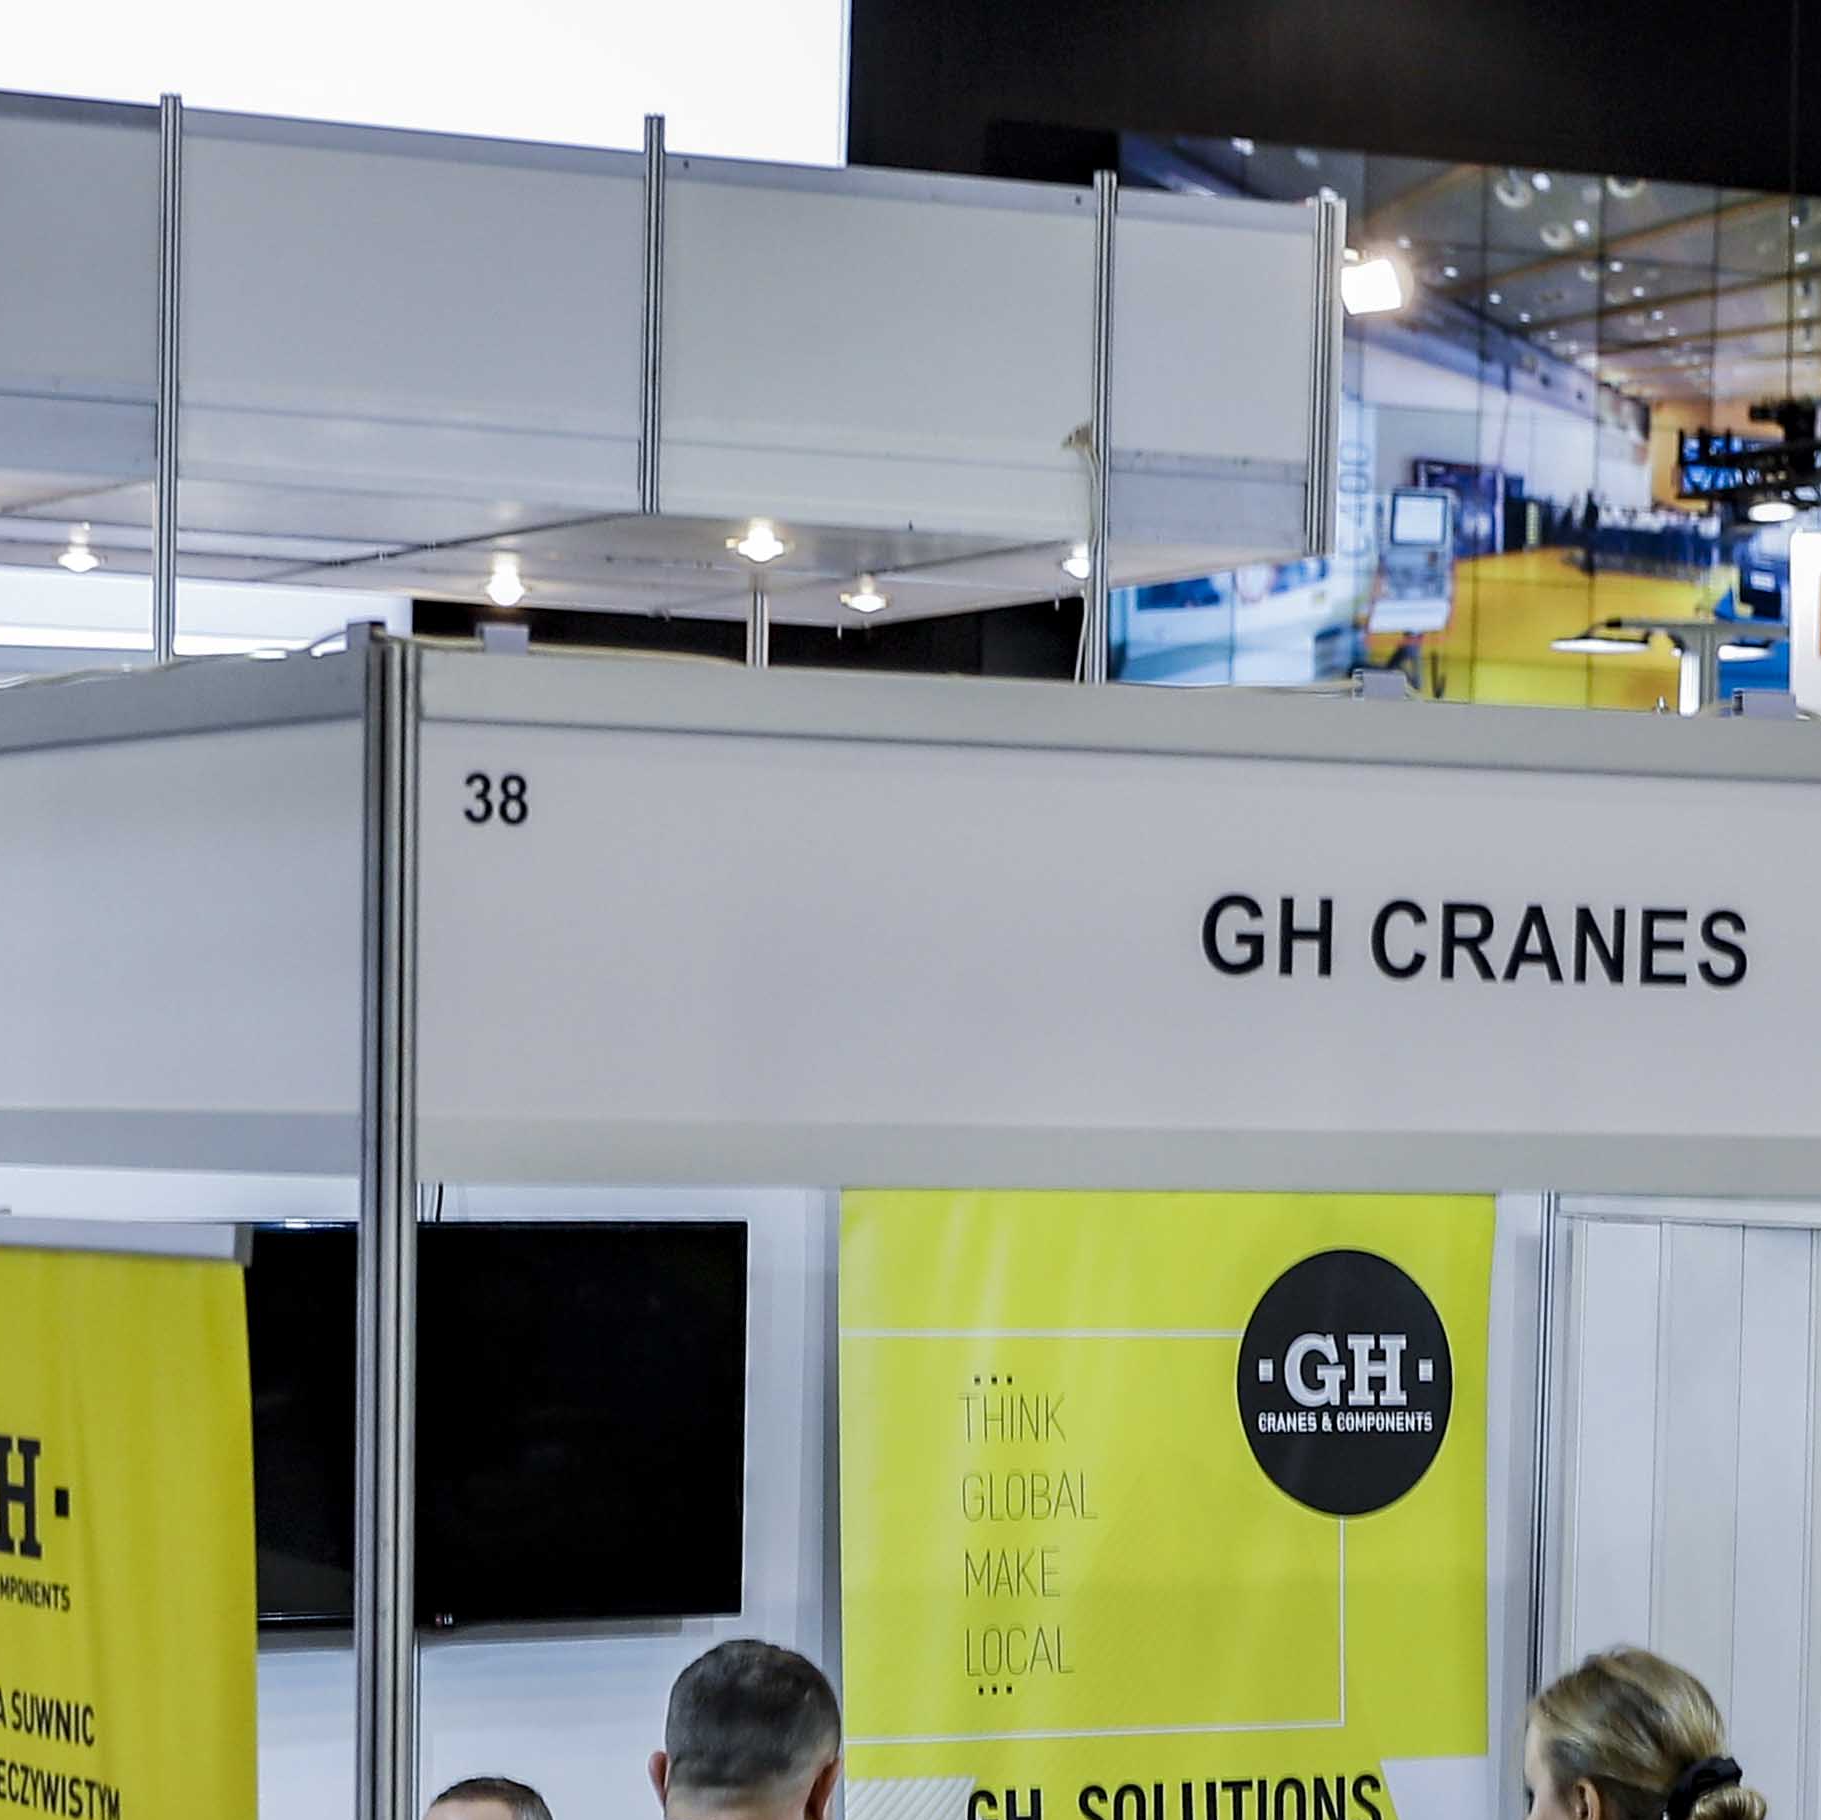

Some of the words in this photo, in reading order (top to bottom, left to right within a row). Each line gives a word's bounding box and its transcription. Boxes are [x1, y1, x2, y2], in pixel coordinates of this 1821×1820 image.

[463, 773, 529, 826] 38
[1201, 895, 1333, 978] GH
[1370, 900, 1750, 988] CRANES
[1284, 1332, 1408, 1407] GH
[959, 1392, 1066, 1445] THINK
[1258, 1412, 1318, 1434] CRANES
[1322, 1412, 1333, 1433] &
[1337, 1411, 1433, 1434] COMPONENTS
[960, 1470, 1099, 1523] GLOBAL
[963, 1547, 1061, 1599] MAKE
[964, 1625, 1075, 1677] LOCAL
[11, 1689, 95, 1747] SUWNIC
